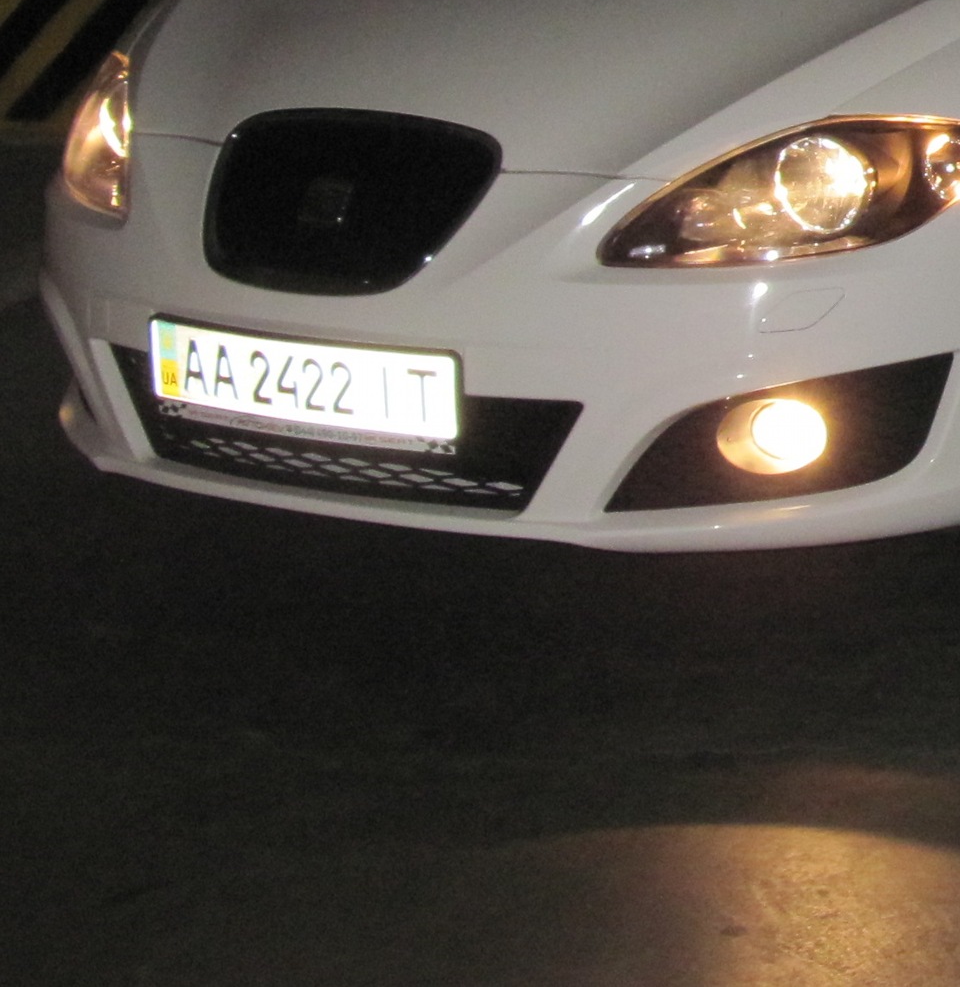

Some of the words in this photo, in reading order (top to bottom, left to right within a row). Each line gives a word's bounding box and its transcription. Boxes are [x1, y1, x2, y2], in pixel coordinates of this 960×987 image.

[162, 370, 179, 388] UA
[184, 339, 239, 400] AA
[250, 350, 355, 415] 2422
